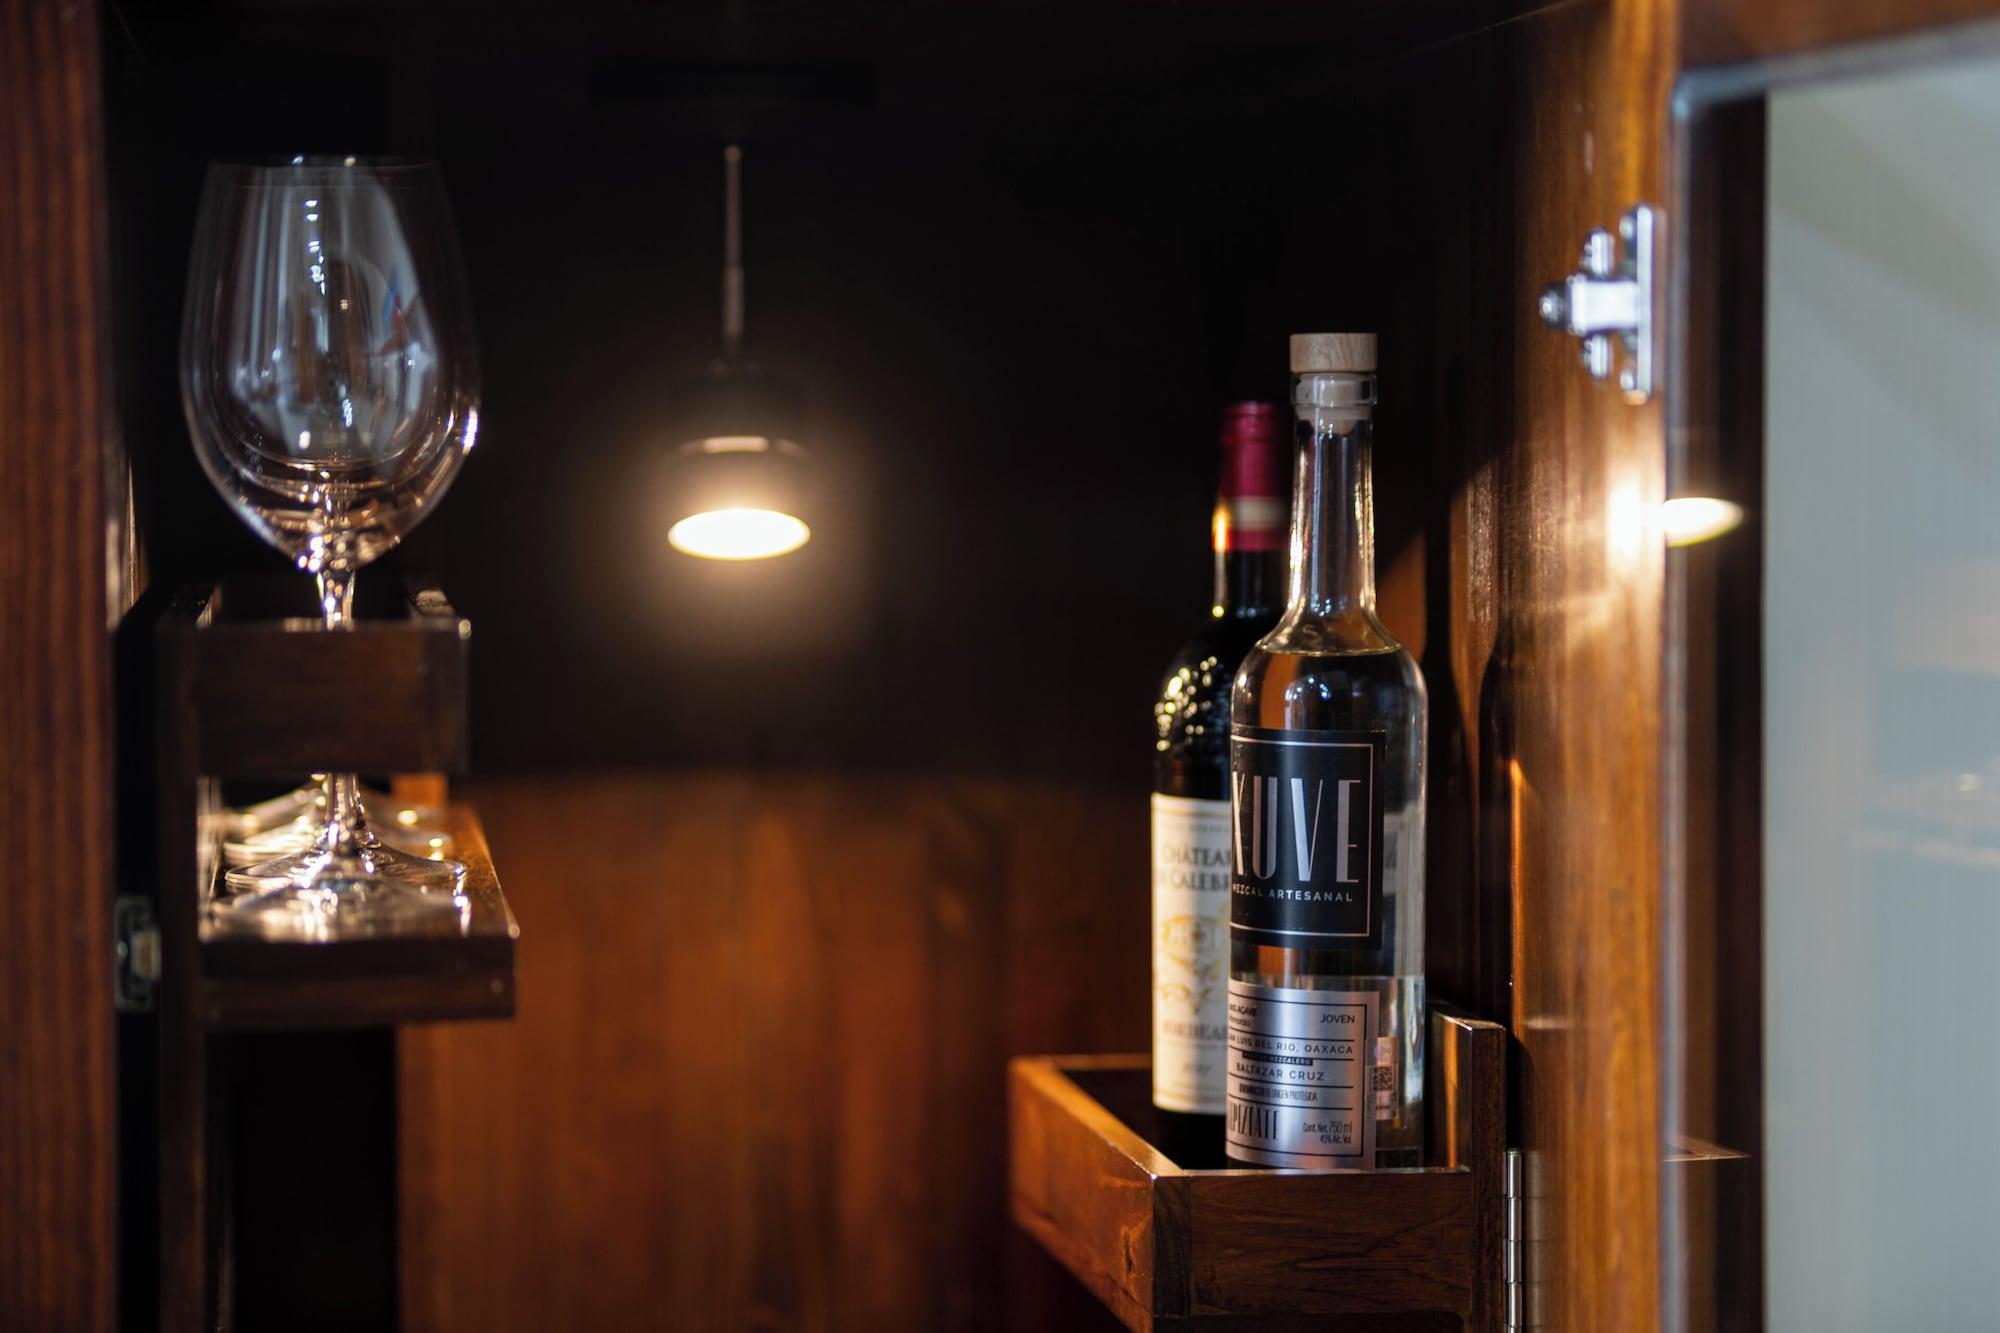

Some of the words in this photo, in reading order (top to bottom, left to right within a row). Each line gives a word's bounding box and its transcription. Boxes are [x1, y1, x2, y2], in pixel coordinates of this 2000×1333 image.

[1232, 883, 1263, 897] MEZCAL
[1268, 889, 1353, 902] ARTESANAL
[1320, 1014, 1355, 1024] JOVEN
[1237, 1035, 1253, 1046] LUIS
[1255, 1039, 1273, 1050] DEL
[1304, 1044, 1354, 1055] OAXACA
[1269, 1056, 1311, 1065] MEZCALERO
[1236, 1062, 1283, 1077] BALTAZAR
[1289, 1070, 1325, 1081] CRUZ
[1329, 1120, 1342, 1134] 750
[1343, 1120, 1353, 1133] ml
